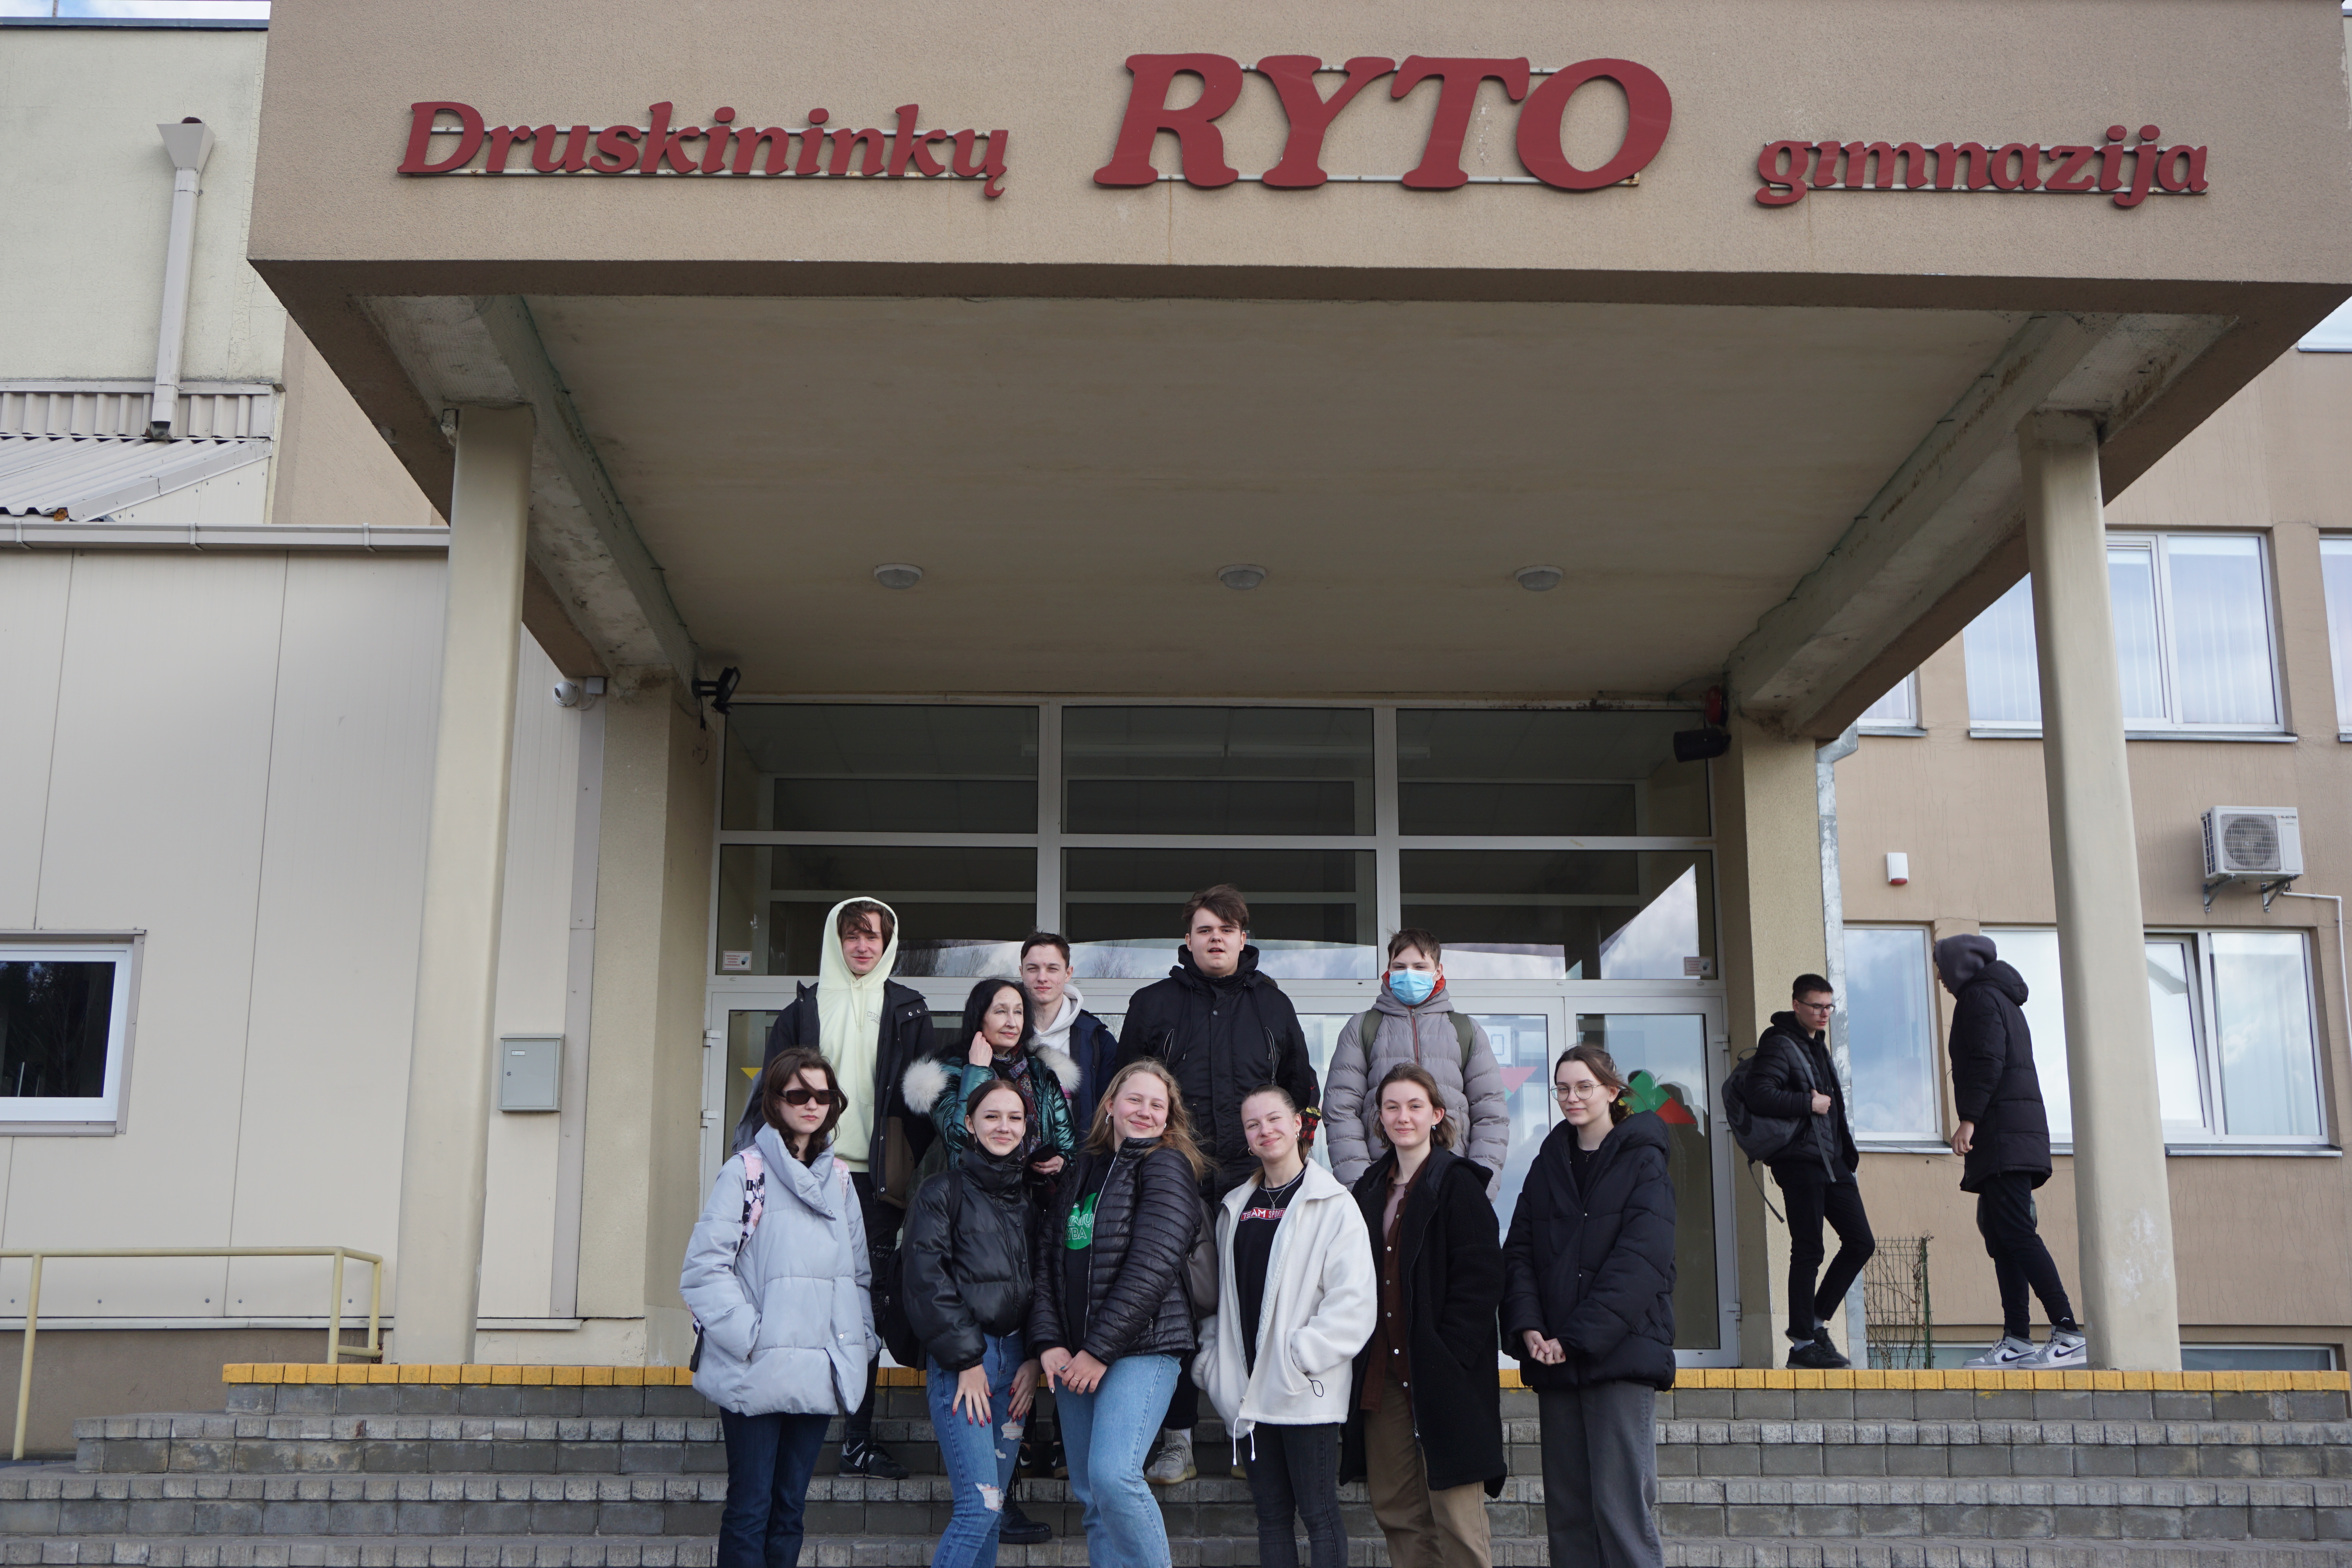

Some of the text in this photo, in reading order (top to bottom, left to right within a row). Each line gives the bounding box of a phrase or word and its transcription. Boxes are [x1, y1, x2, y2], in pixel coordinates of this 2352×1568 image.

[397, 101, 1009, 198] Druskininkų
[1093, 53, 1672, 191] RYTO
[1243, 1209, 1285, 1219] TEAM SPORTI
